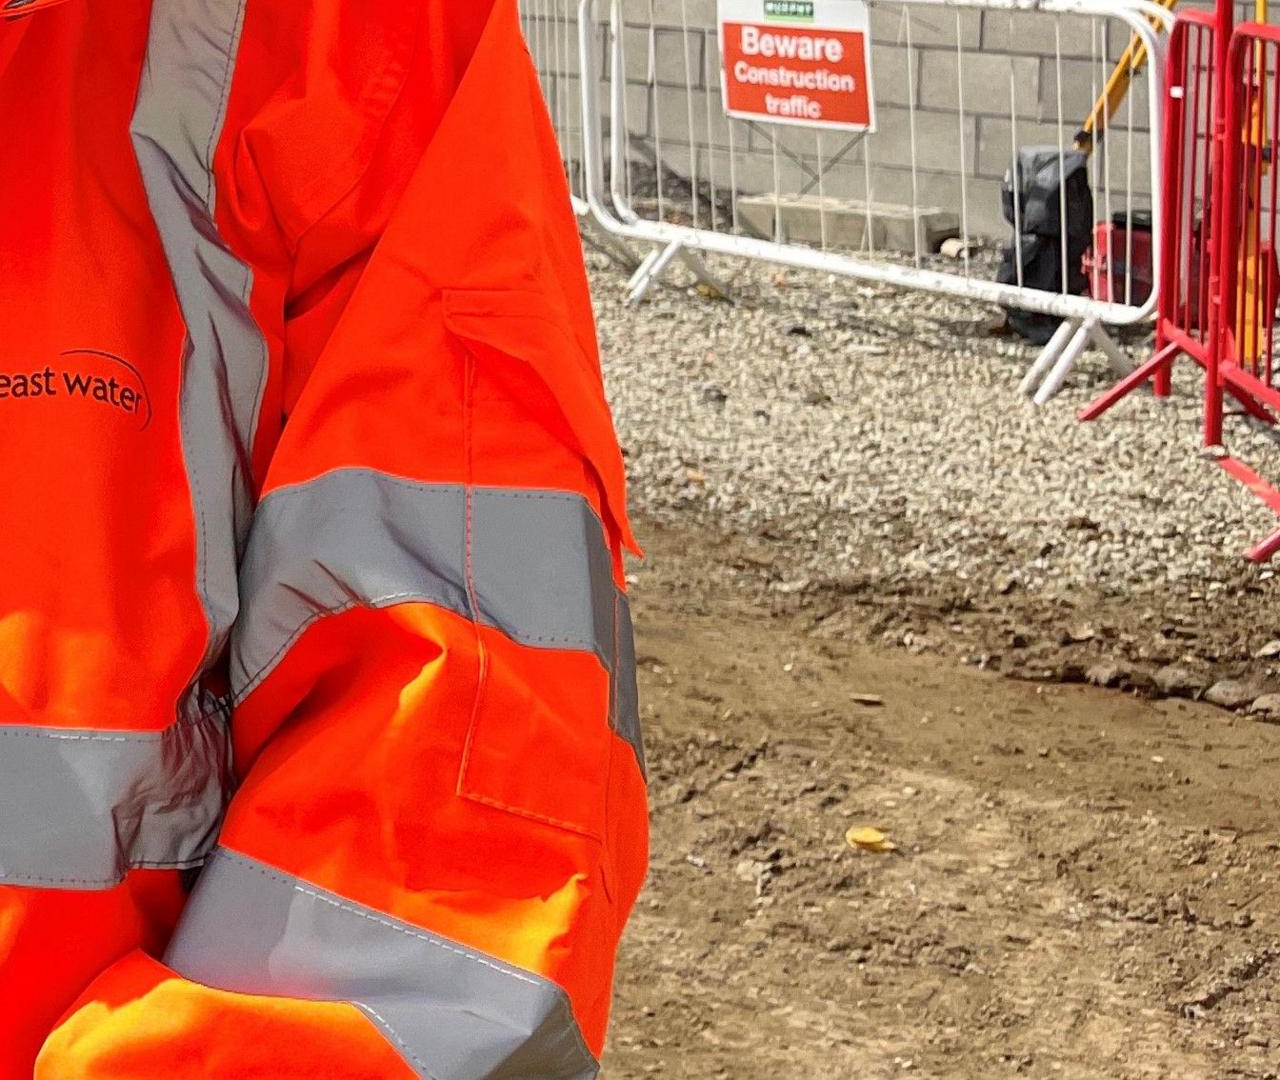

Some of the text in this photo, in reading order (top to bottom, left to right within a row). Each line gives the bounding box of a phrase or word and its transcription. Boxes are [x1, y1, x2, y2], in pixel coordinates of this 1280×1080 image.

[741, 25, 844, 63] Beware
[734, 60, 856, 93] Construction
[765, 92, 822, 118] traffic
[62, 372, 143, 414] water
